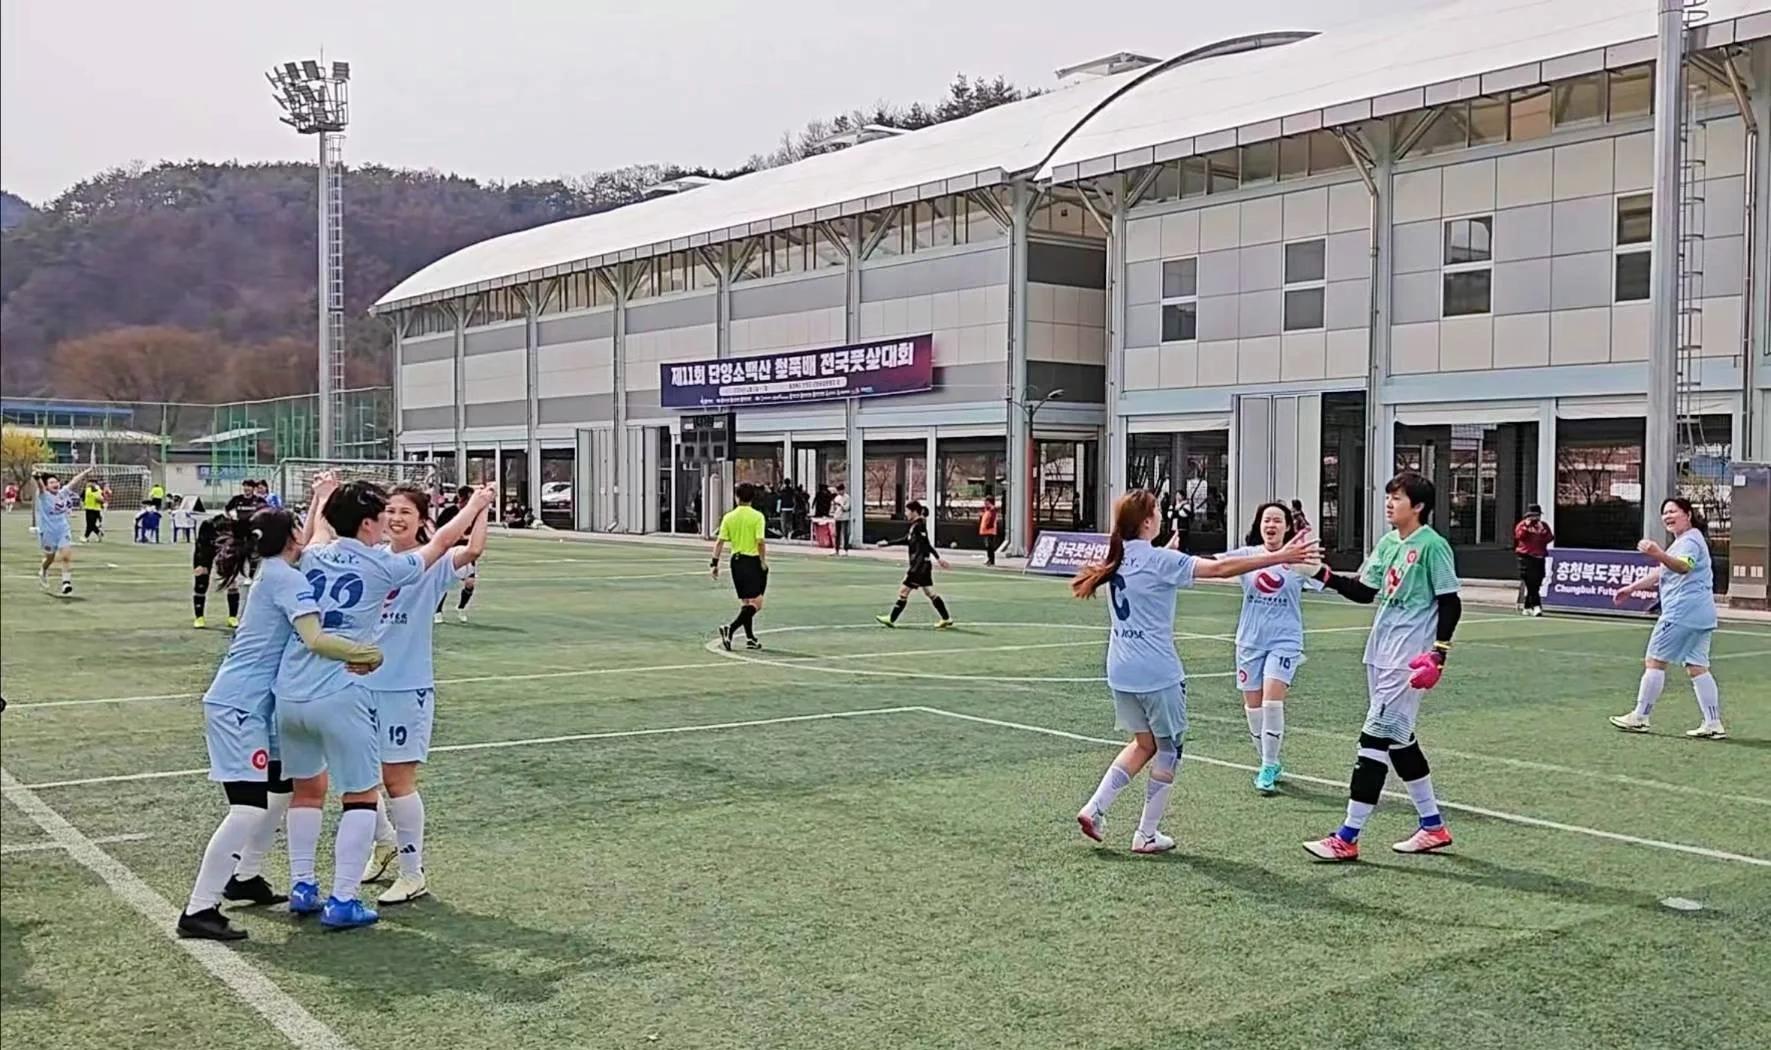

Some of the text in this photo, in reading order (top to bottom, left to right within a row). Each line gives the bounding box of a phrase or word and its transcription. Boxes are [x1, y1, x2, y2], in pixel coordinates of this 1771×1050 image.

[671, 342, 914, 386] 제11회 단양소백산 철쭉배 전국풋살대회
[1555, 584, 1596, 596] Chungbuk
[1631, 590, 1658, 600] eague
